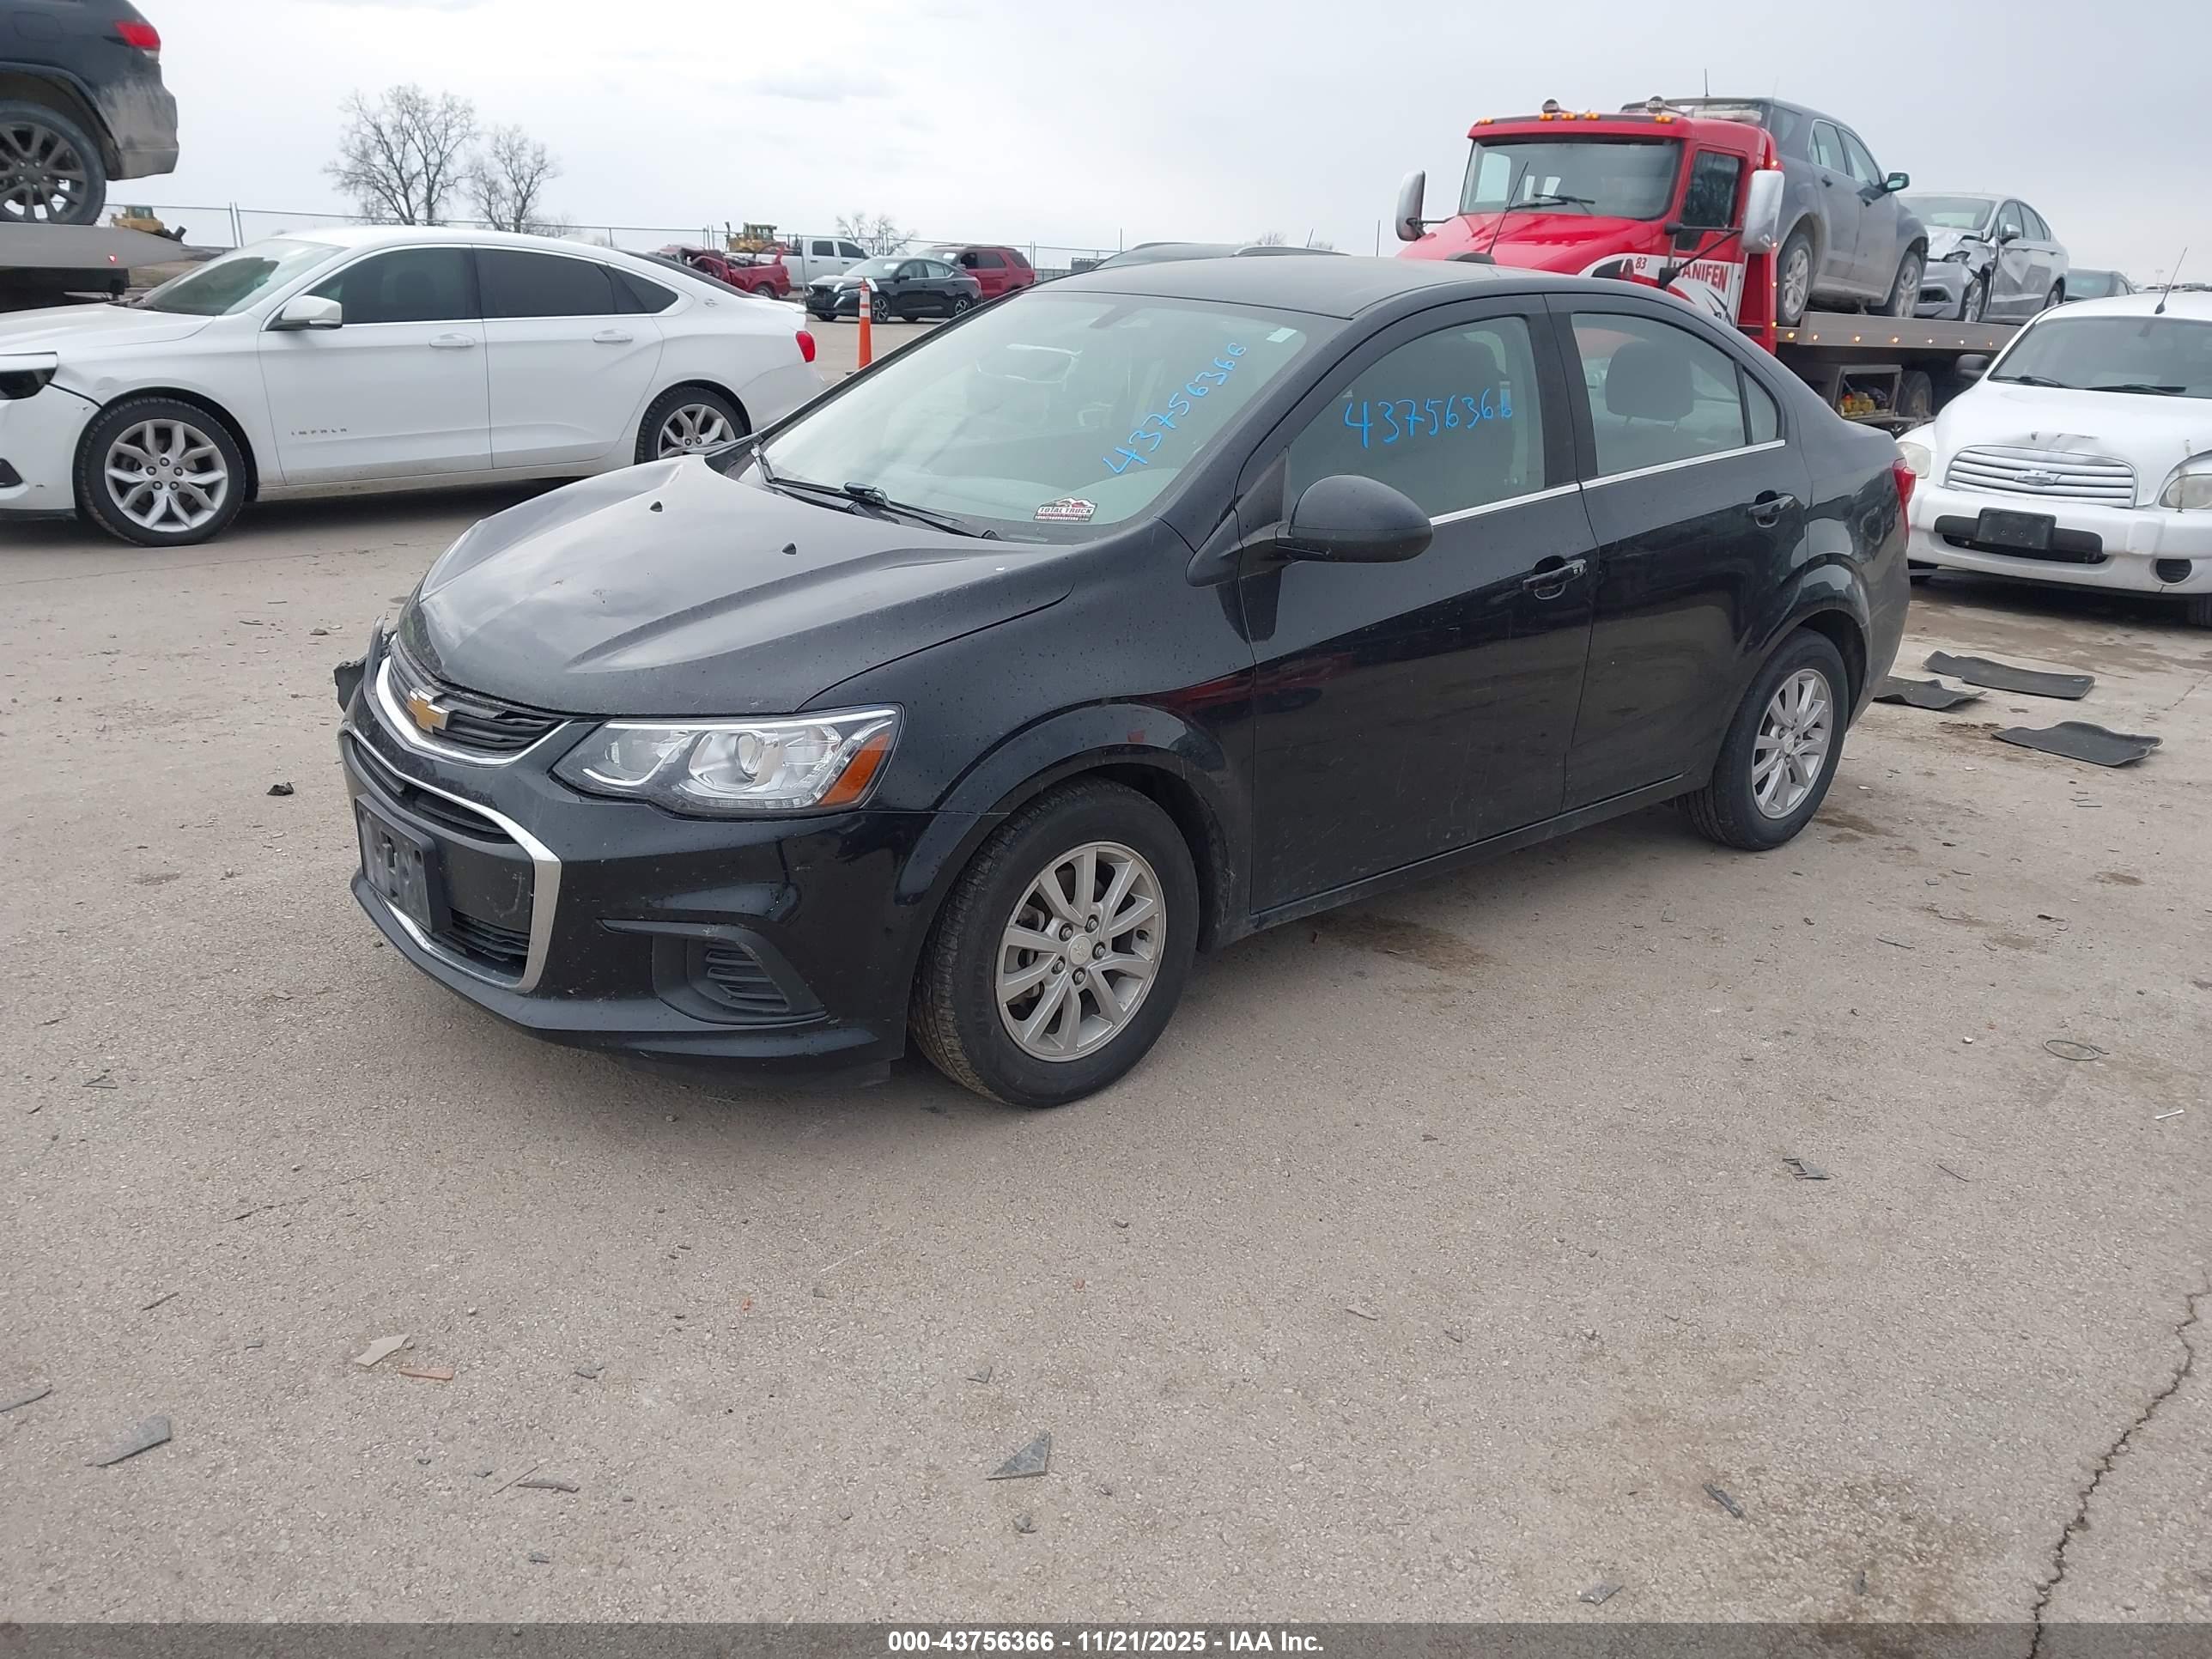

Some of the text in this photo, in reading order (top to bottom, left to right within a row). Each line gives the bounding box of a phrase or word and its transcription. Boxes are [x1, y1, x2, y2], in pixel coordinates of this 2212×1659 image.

[1635, 257, 1647, 270] 83
[1103, 343, 1246, 473] 43756366
[1344, 388, 1512, 448] 43756366
